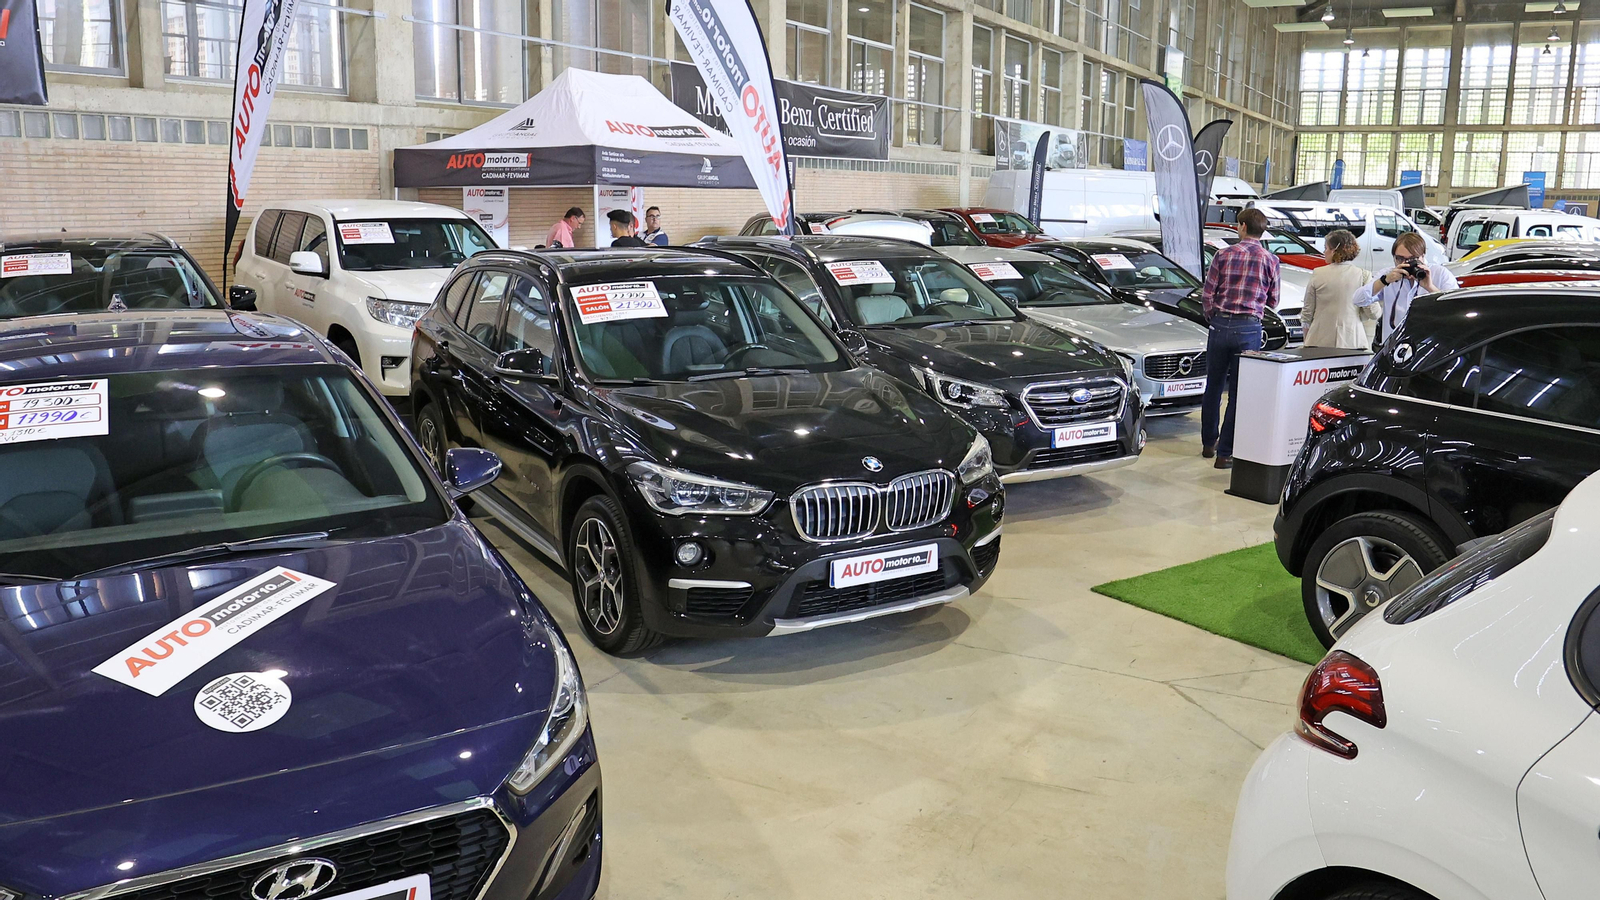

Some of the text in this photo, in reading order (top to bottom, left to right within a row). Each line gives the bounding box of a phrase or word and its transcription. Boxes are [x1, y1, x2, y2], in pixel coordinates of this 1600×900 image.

[235, 63, 261, 160] AUTO
[818, 104, 874, 133] Certified
[605, 120, 655, 137] AUTO
[655, 127, 704, 137] motor10
[789, 135, 816, 148] ocasión
[446, 153, 527, 169] AUTO motor10
[467, 188, 485, 197] AUTO
[599, 189, 613, 197] AUTO
[578, 284, 610, 294] AUTO
[585, 303, 610, 312] SALÓN
[1293, 368, 1358, 386] AUTO motor10
[27, 384, 90, 393] motor10
[1167, 383, 1185, 392] AUTO
[1058, 428, 1109, 442] AUTO motor10
[840, 558, 884, 579] AUTO
[886, 554, 927, 568] motor10
[227, 582, 319, 635] CADIMAR-FEVIMAR
[124, 619, 212, 679] AUTO
